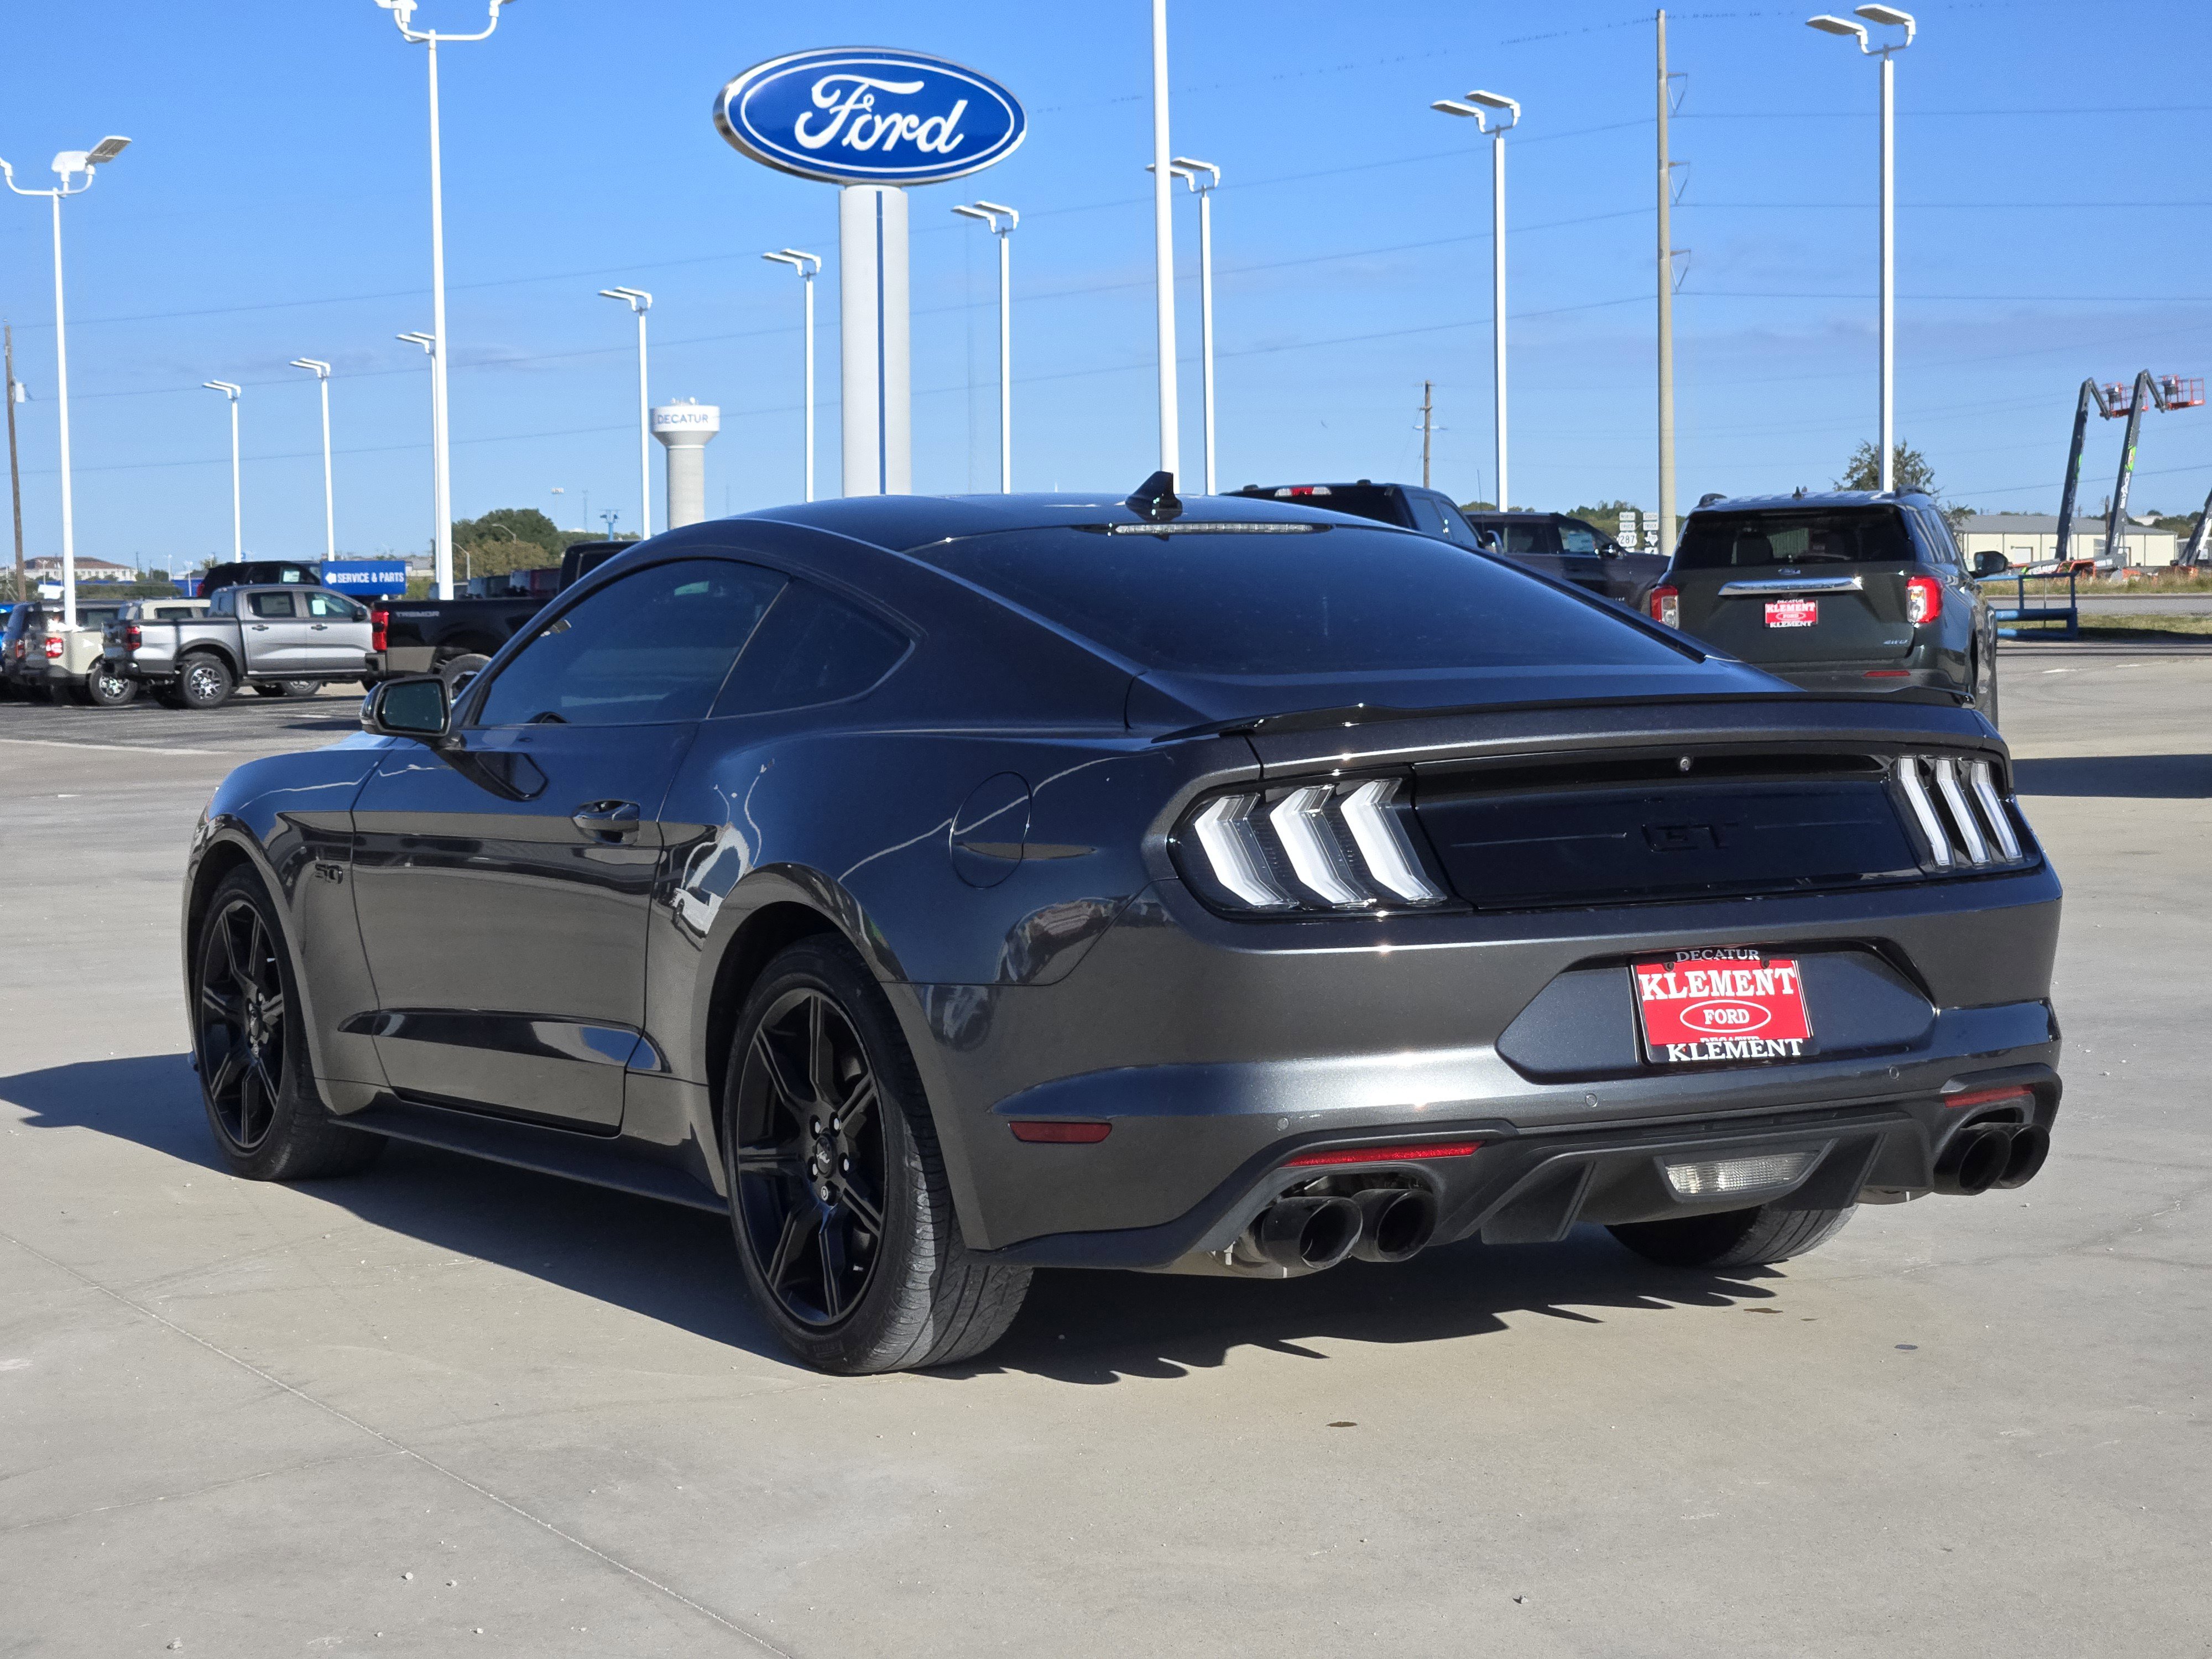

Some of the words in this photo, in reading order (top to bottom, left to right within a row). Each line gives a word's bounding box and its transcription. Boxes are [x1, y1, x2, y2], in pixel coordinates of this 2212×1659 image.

[794, 74, 968, 153] Ford
[658, 414, 709, 424] DECATUR
[1620, 535, 1635, 544] 287
[337, 572, 370, 583] SERVICE
[371, 572, 377, 583] &
[379, 572, 404, 582] PARTS
[1766, 602, 1815, 613] KLEMENT
[1676, 949, 1760, 963] DECATUR
[1638, 967, 1796, 1001] KLEMENT
[1703, 1009, 1750, 1025] FORD
[1666, 1038, 1804, 1062] KLEMENT
